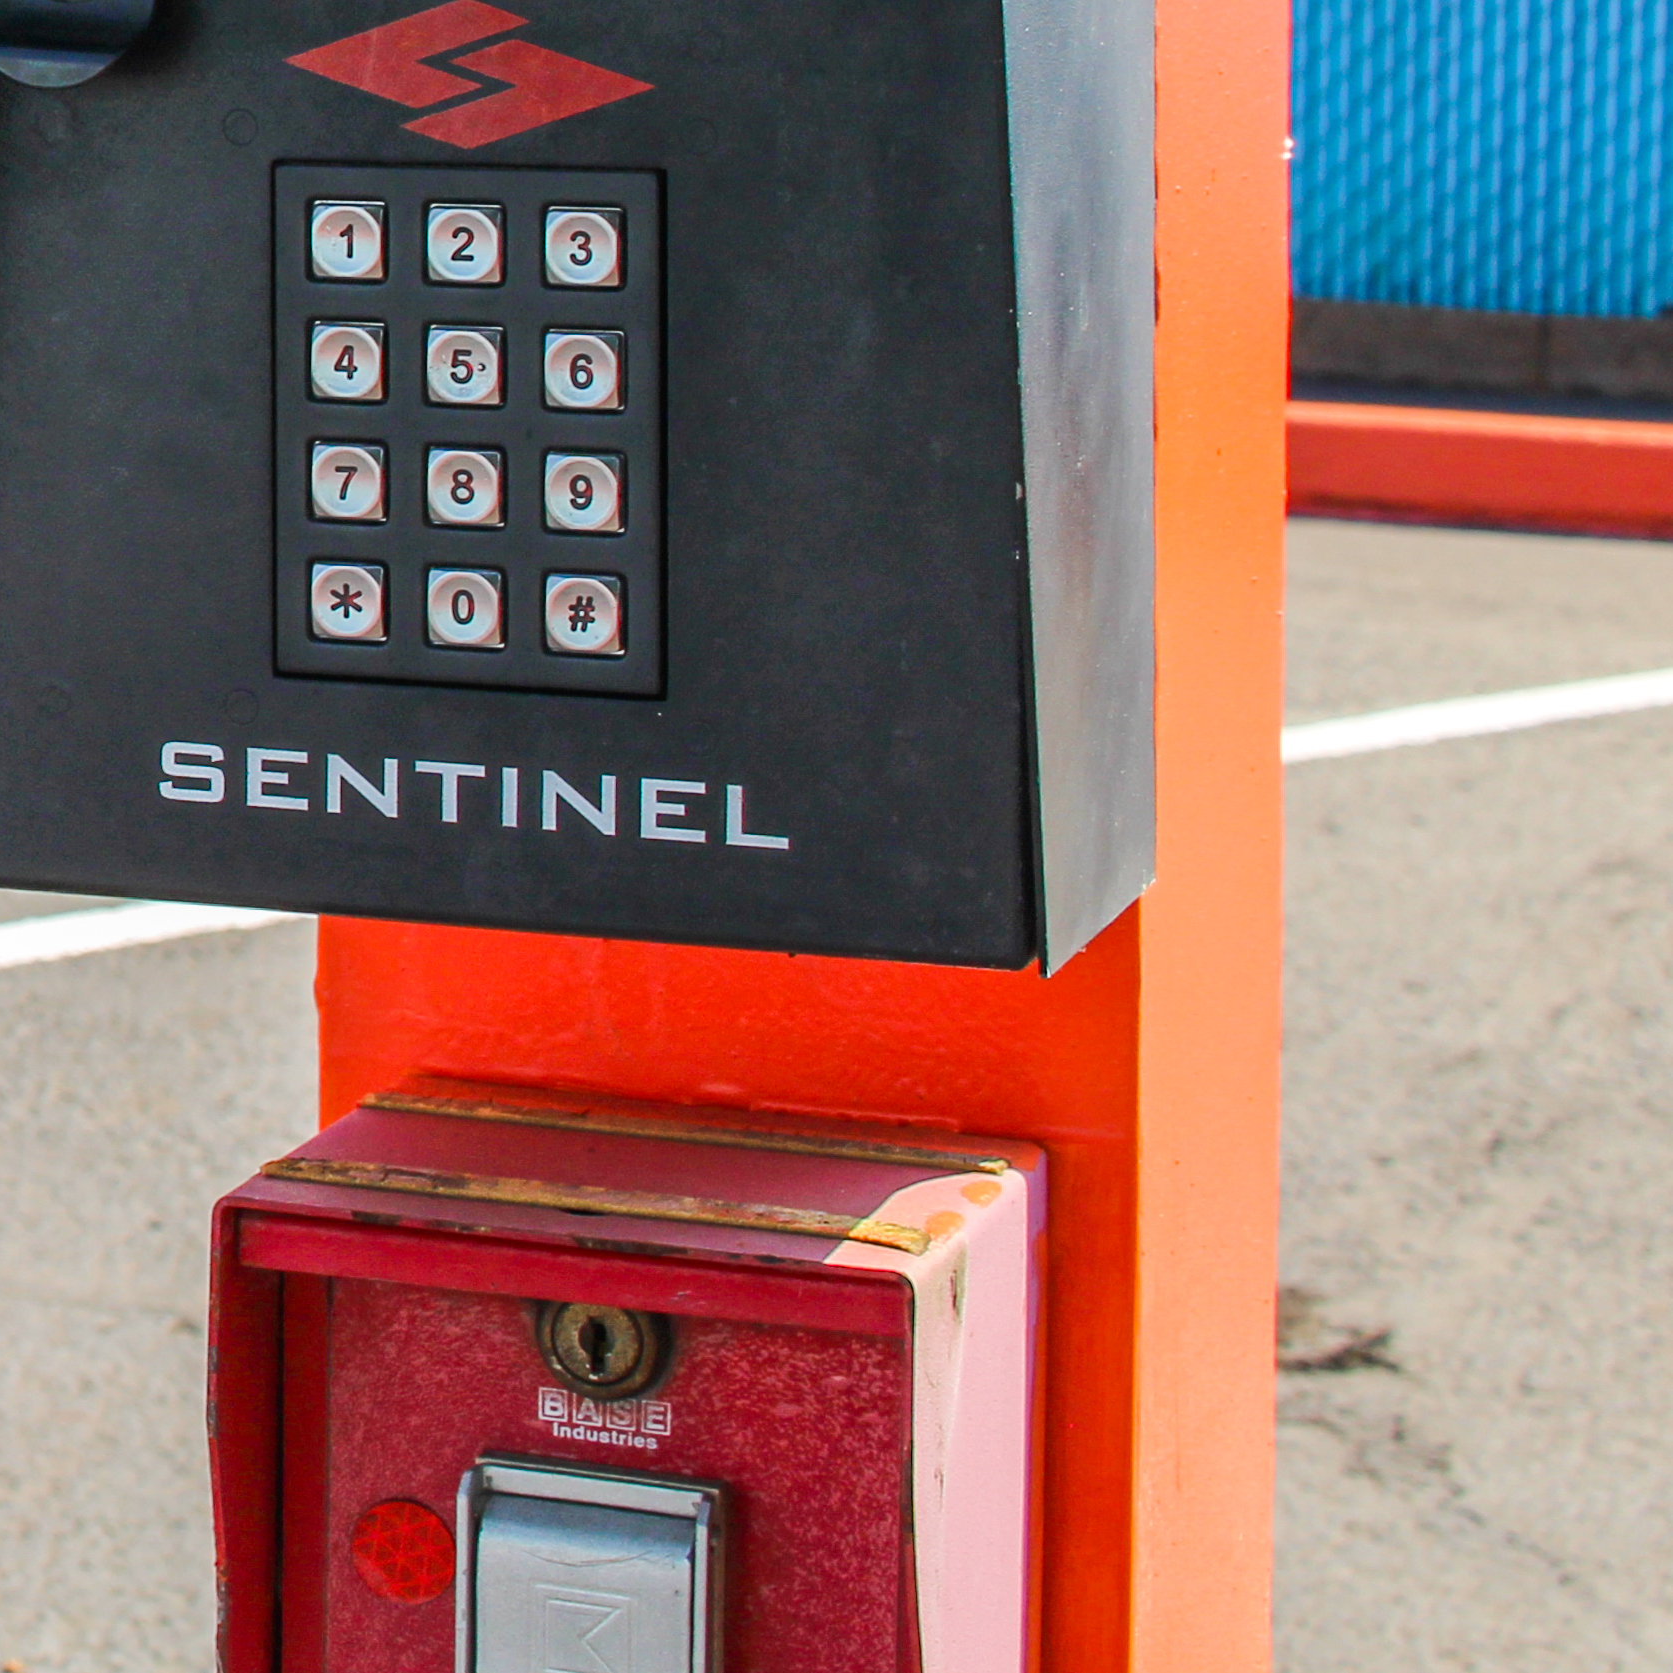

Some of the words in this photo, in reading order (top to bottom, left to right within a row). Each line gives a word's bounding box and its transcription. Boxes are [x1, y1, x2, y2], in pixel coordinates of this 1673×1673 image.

[339, 224, 354, 258] 1
[451, 226, 475, 262] 2
[569, 230, 592, 267] 3
[334, 344, 358, 380] 4
[450, 349, 473, 385] 5
[569, 353, 594, 390] 6
[334, 465, 358, 500] 7
[451, 469, 475, 504] 8
[569, 474, 593, 510] 9
[451, 589, 474, 625] 0
[568, 596, 596, 633] #
[158, 741, 790, 851] SENTINEL
[540, 1389, 668, 1433] BASE
[552, 1422, 658, 1450] Industries
